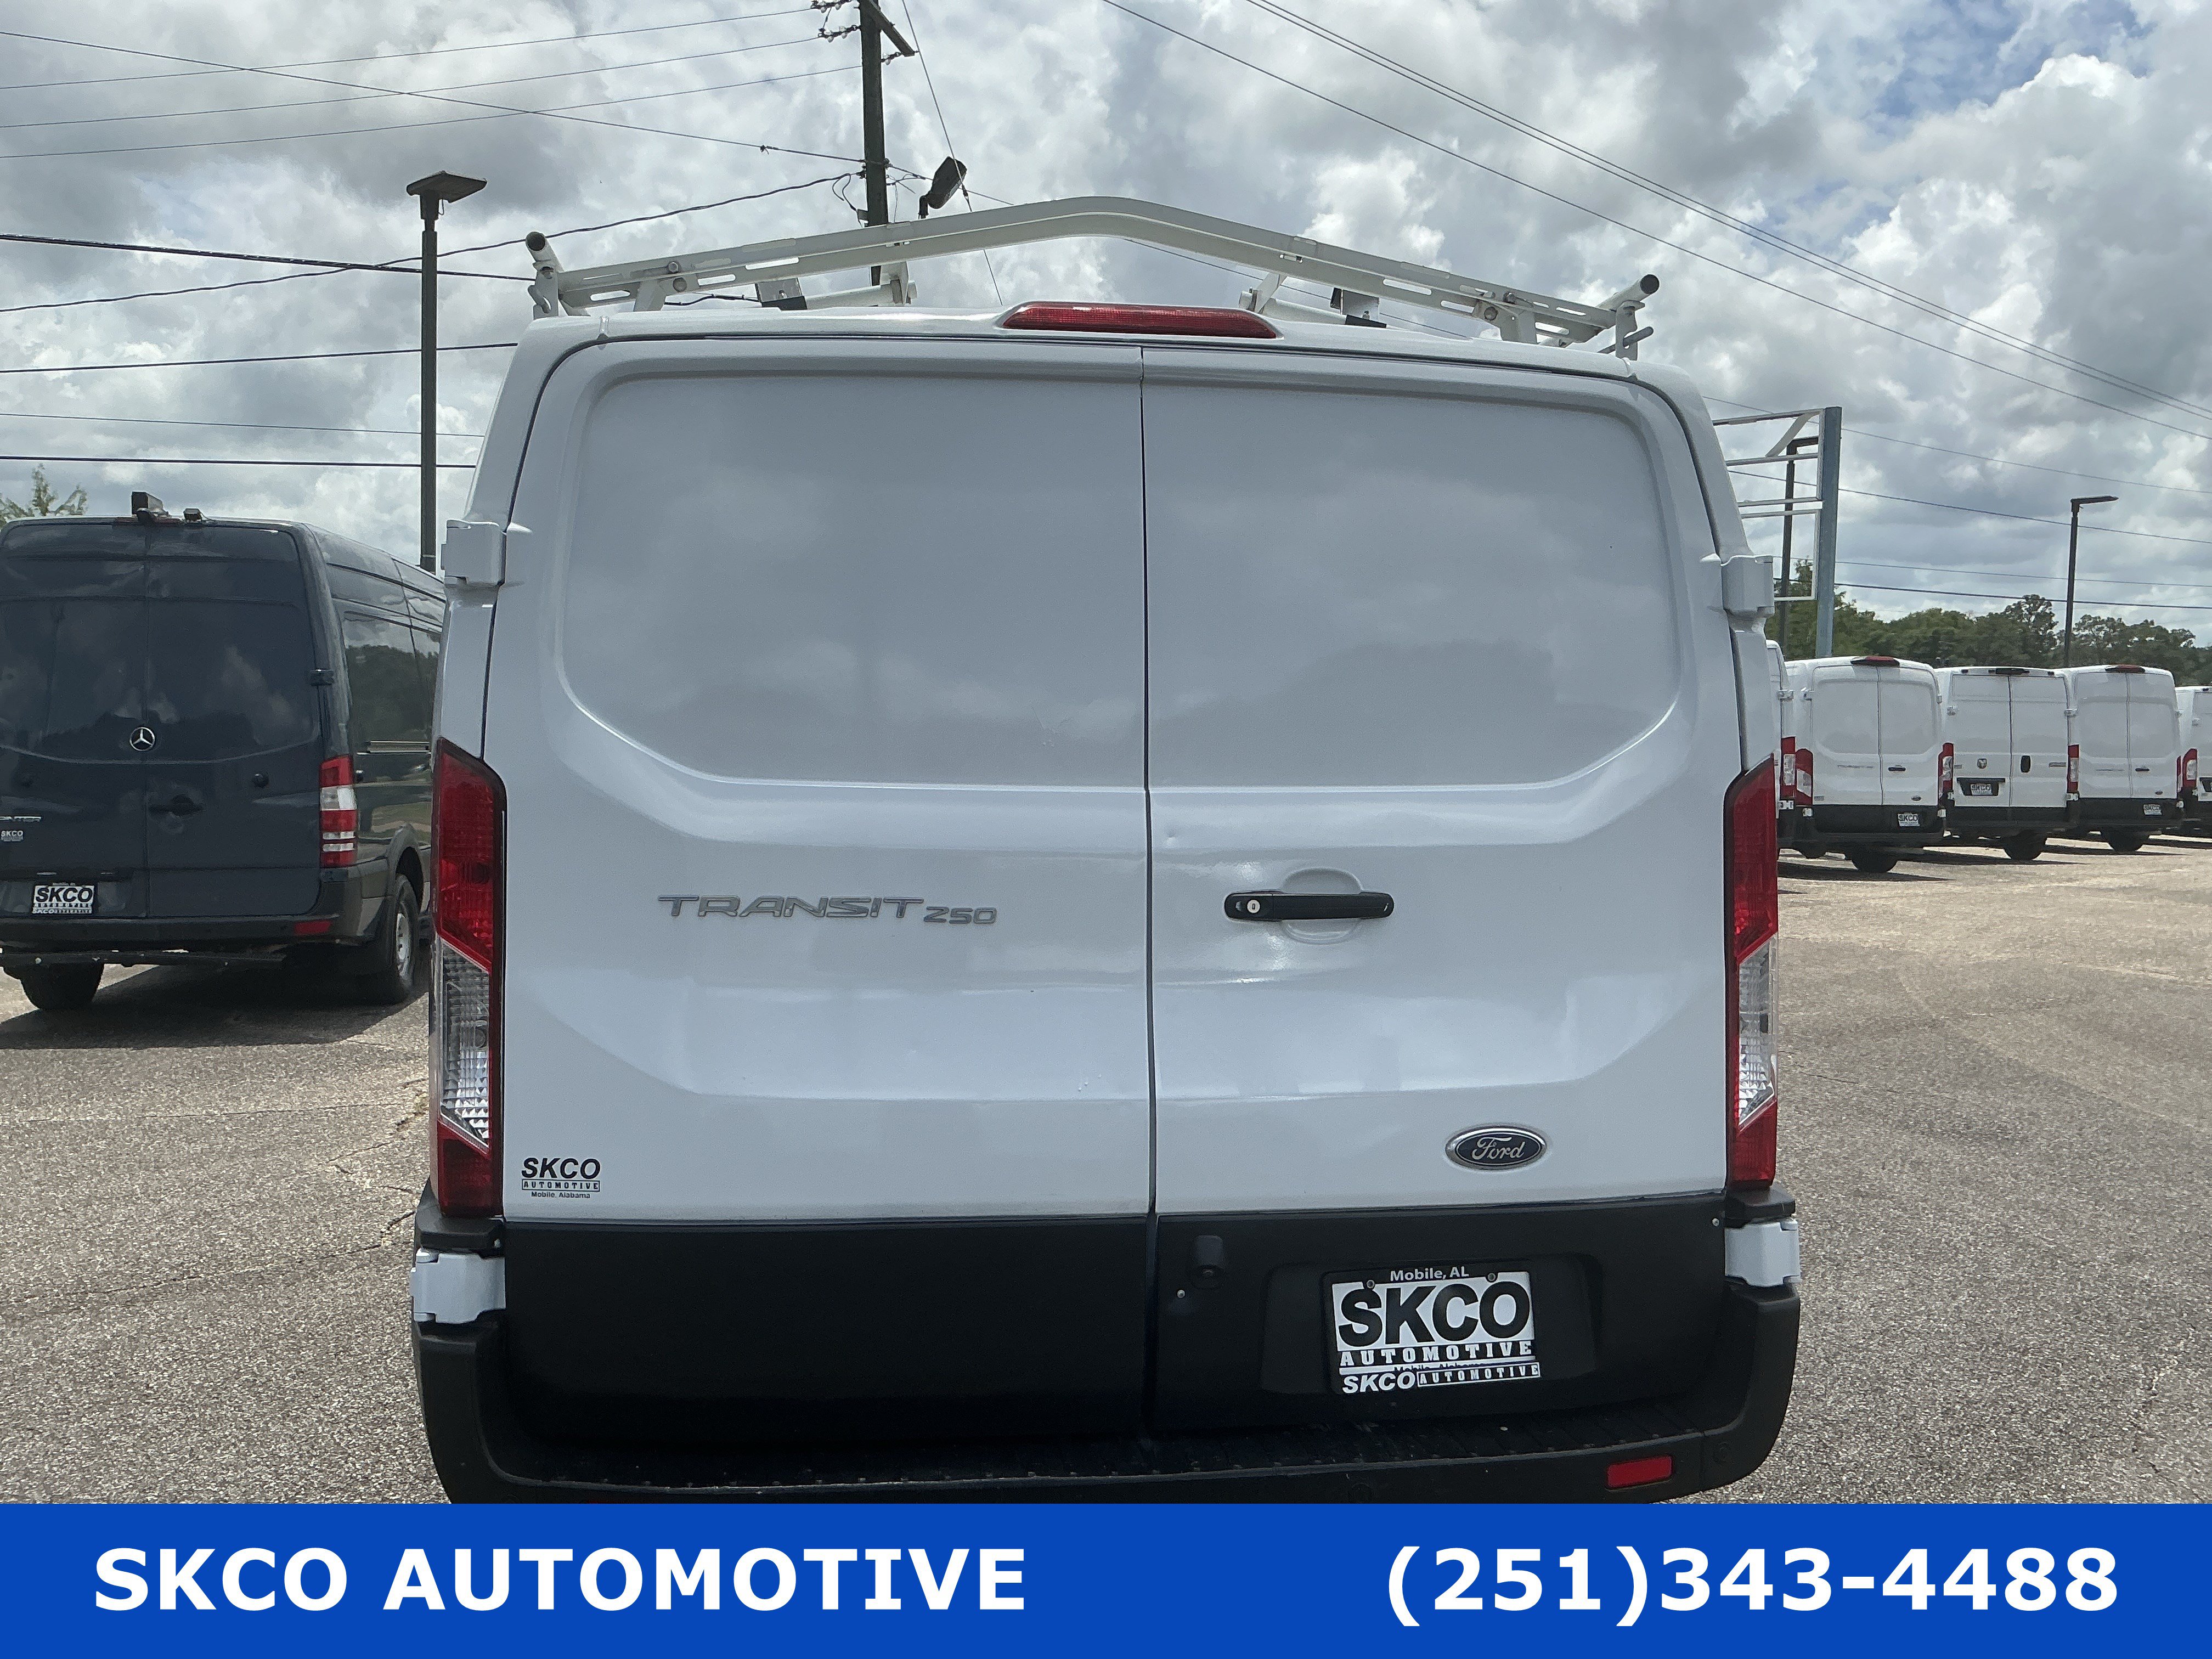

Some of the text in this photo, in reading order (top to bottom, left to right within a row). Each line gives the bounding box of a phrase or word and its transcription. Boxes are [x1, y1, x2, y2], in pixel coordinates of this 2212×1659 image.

[36, 887, 92, 902] SKCO
[658, 895, 997, 924] TRANSIT 250
[1472, 1137, 1525, 1160] Ford
[521, 1157, 601, 1179] SKCO
[523, 1181, 599, 1189] AUTOMOTIVE
[1390, 1266, 1469, 1282] Mobile, AL
[1339, 1281, 1530, 1347] SKCO
[1340, 1340, 1532, 1367] AUTOMOTIVE
[1342, 1364, 1539, 1393] SKCO AUTOMOTIVE
